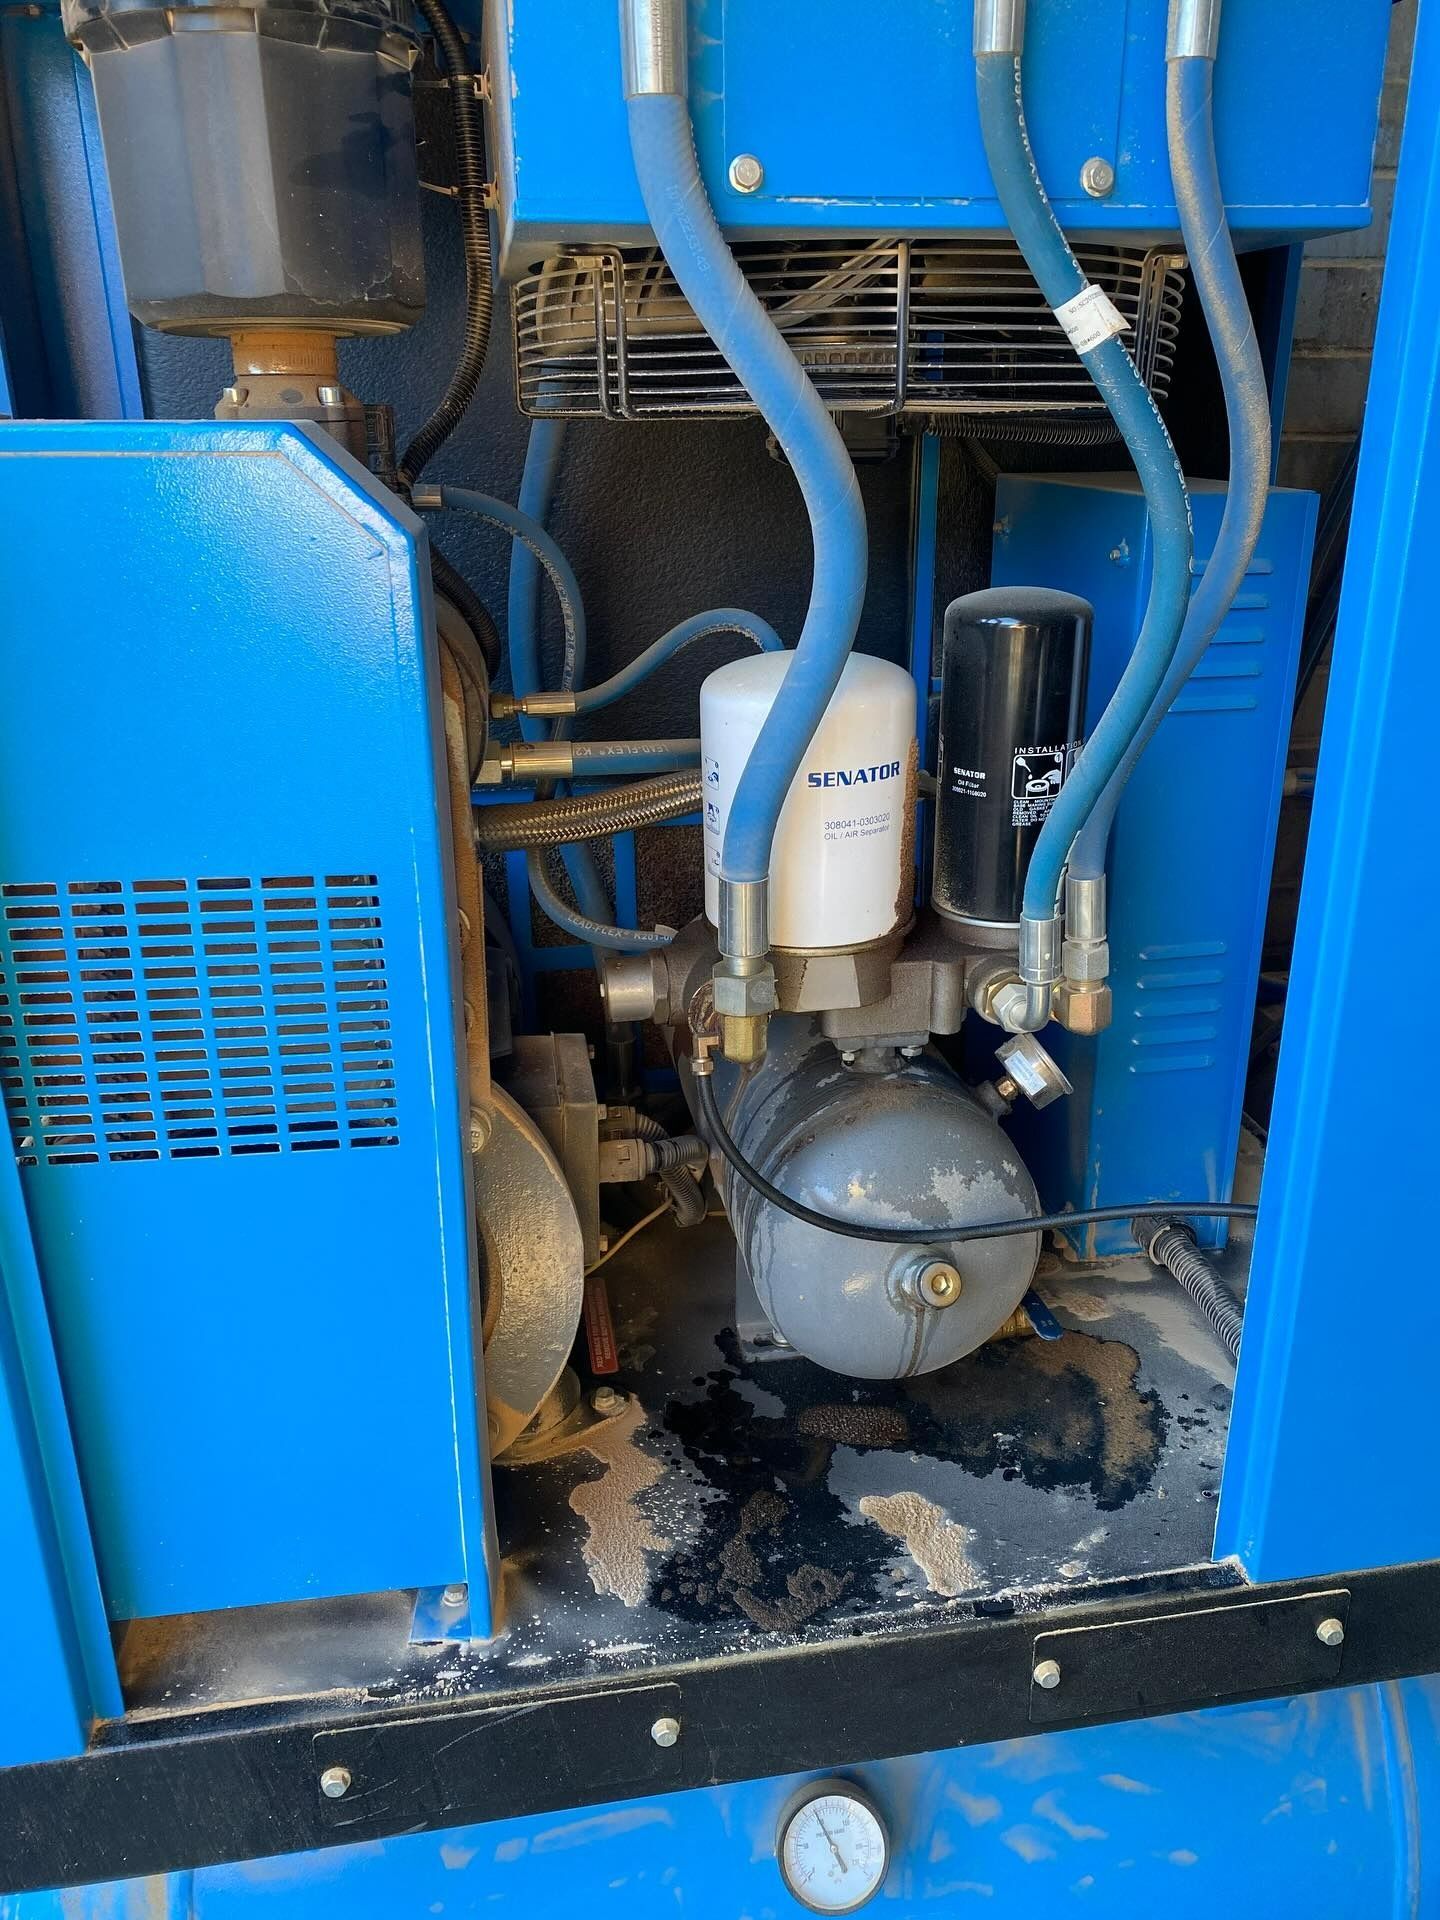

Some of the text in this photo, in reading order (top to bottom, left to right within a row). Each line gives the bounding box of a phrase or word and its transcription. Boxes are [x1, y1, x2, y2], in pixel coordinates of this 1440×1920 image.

[1014, 740, 1082, 754] INSTALLATION
[808, 761, 900, 788] SENATOR
[953, 766, 986, 780] SENATOR
[965, 781, 980, 789] Filter
[824, 812, 891, 830] 308041-0303020
[824, 832, 838, 840] OIL
[844, 830, 858, 839] AIR
[860, 824, 890, 838] Separator
